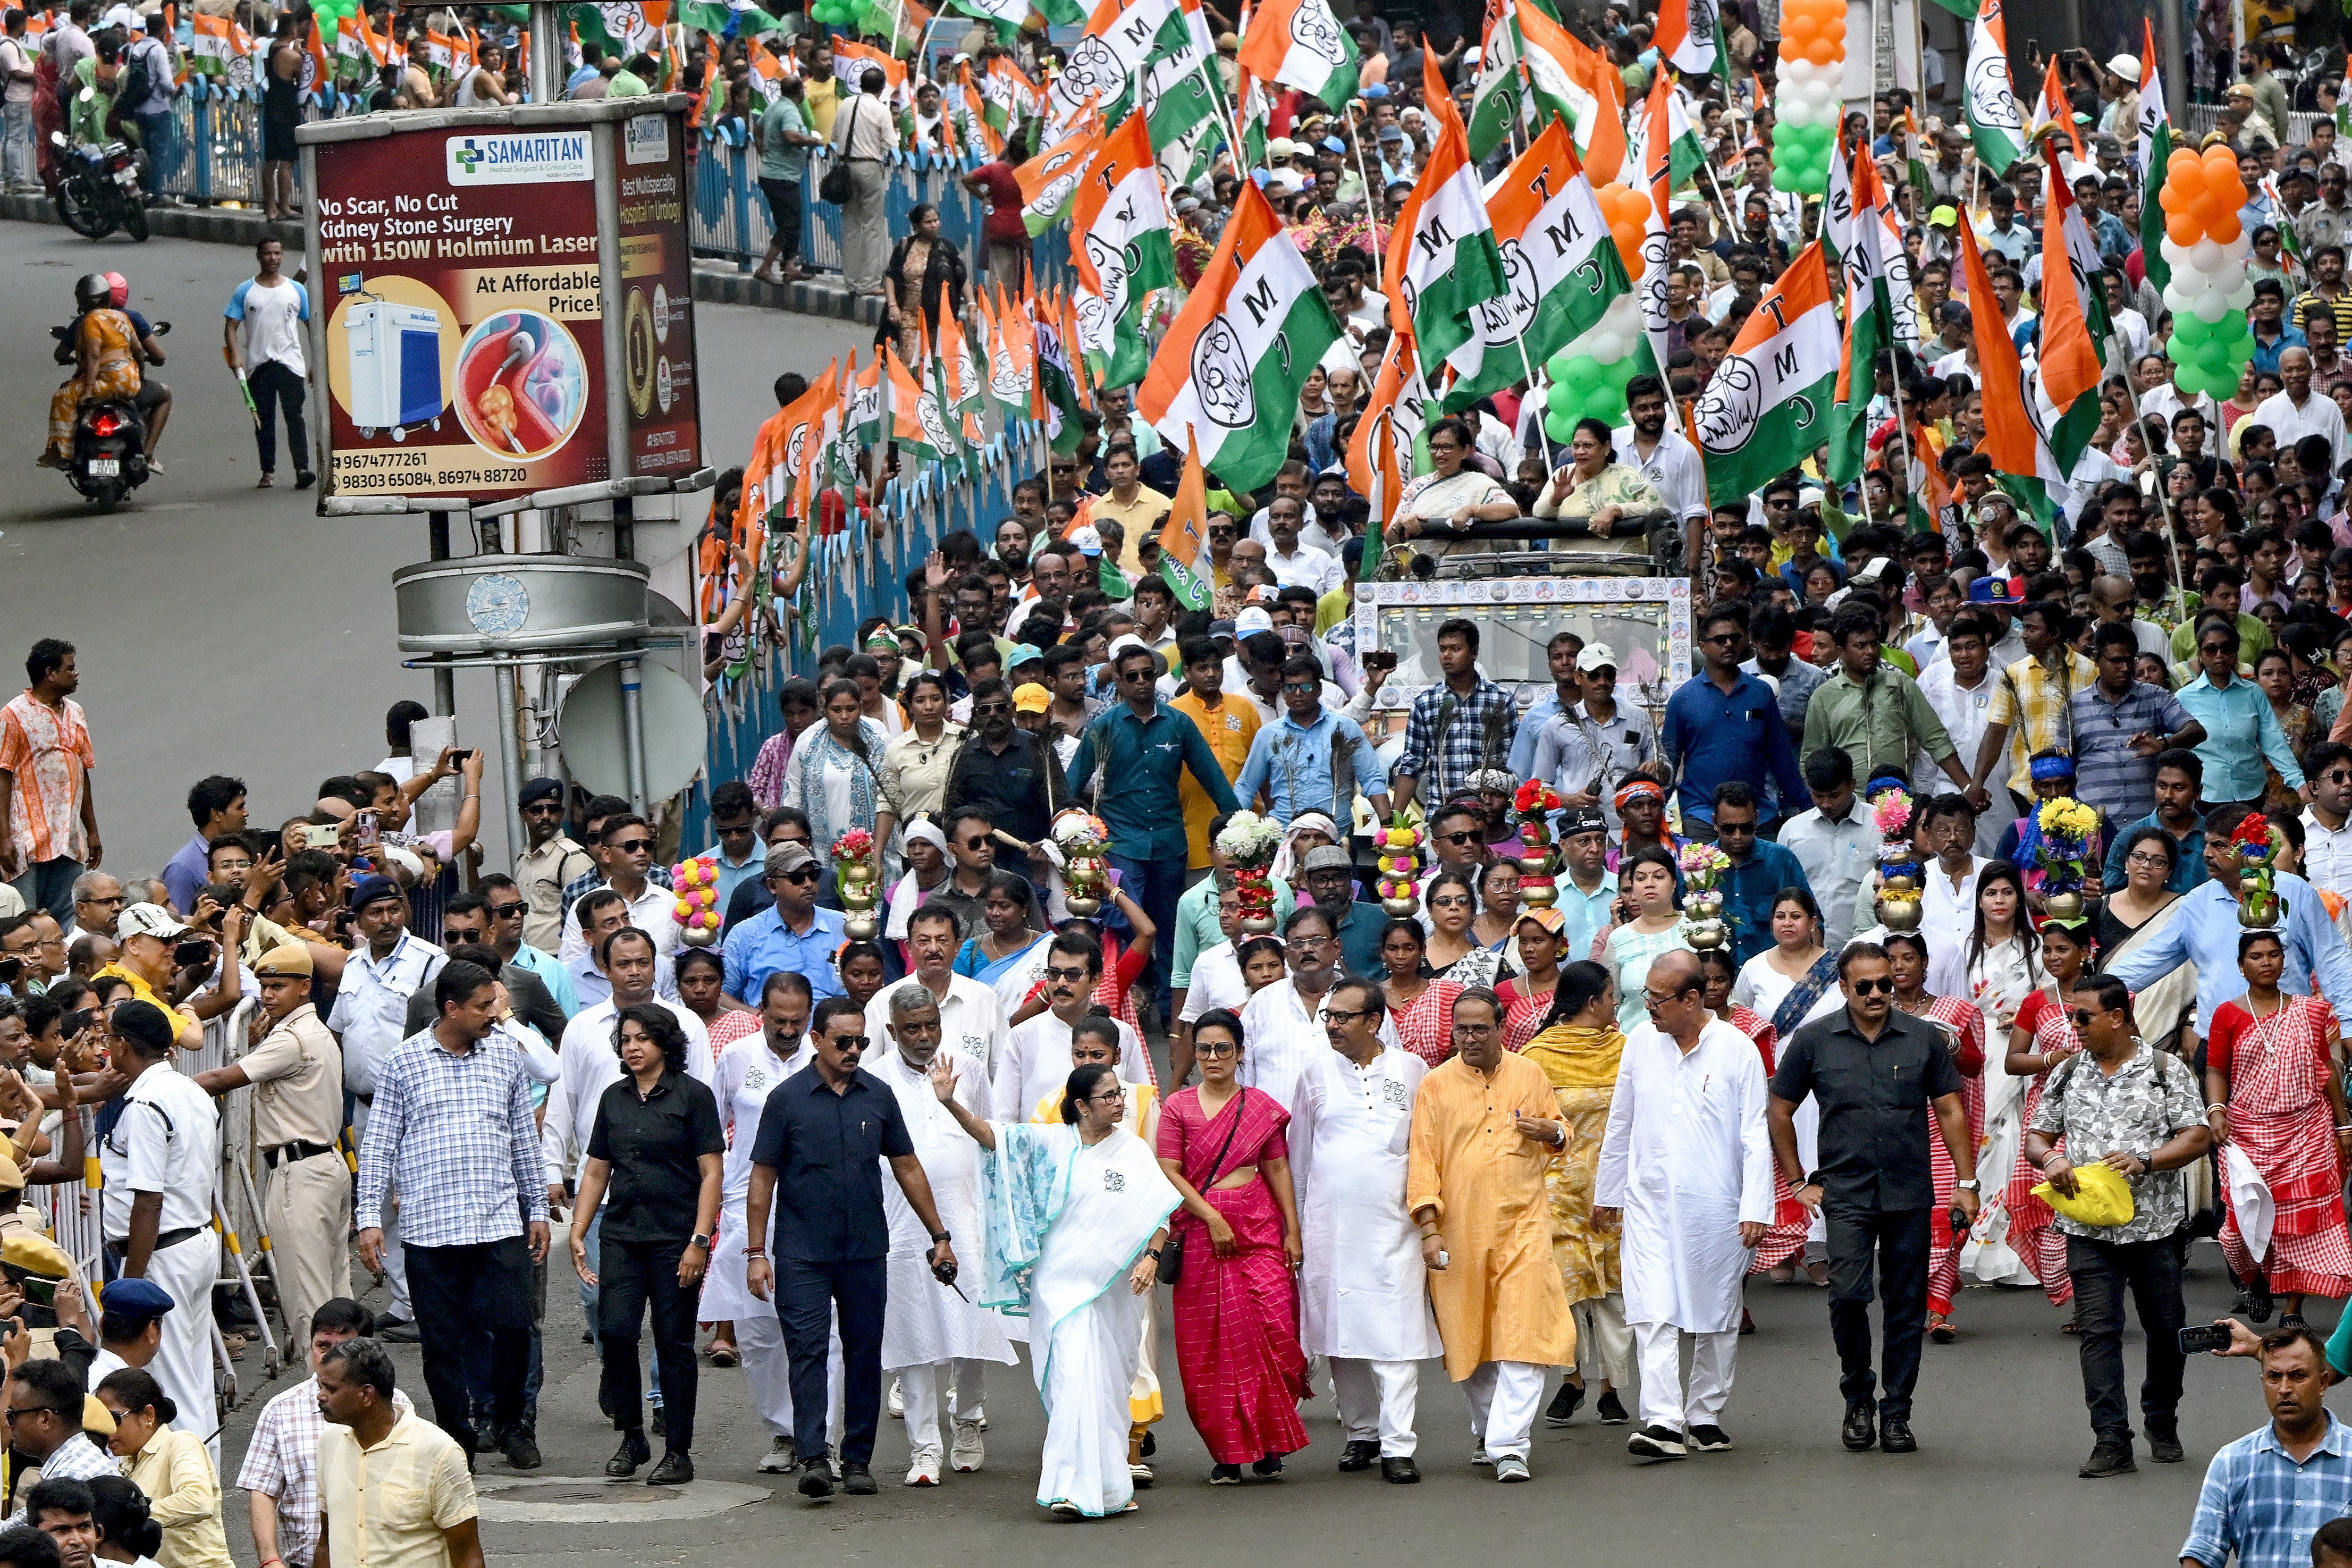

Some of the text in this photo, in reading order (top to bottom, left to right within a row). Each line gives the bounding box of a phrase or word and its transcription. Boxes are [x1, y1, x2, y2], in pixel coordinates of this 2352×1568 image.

[1124, 16, 1153, 47] M
[488, 137, 583, 164] SAMARITAN
[318, 193, 458, 216] No Scar, No Cut
[384, 218, 437, 235] Stone
[442, 215, 513, 235] Surgery
[1416, 214, 1455, 260] M
[321, 241, 367, 263] with
[373, 239, 430, 261] 150W
[437, 234, 534, 258] Holmium
[541, 234, 597, 254] Laser
[477, 271, 600, 293] At Affordable
[549, 293, 601, 313] Price!
[344, 452, 427, 469] 9674777261
[343, 468, 527, 488] 98303 65084, 86974 88720
